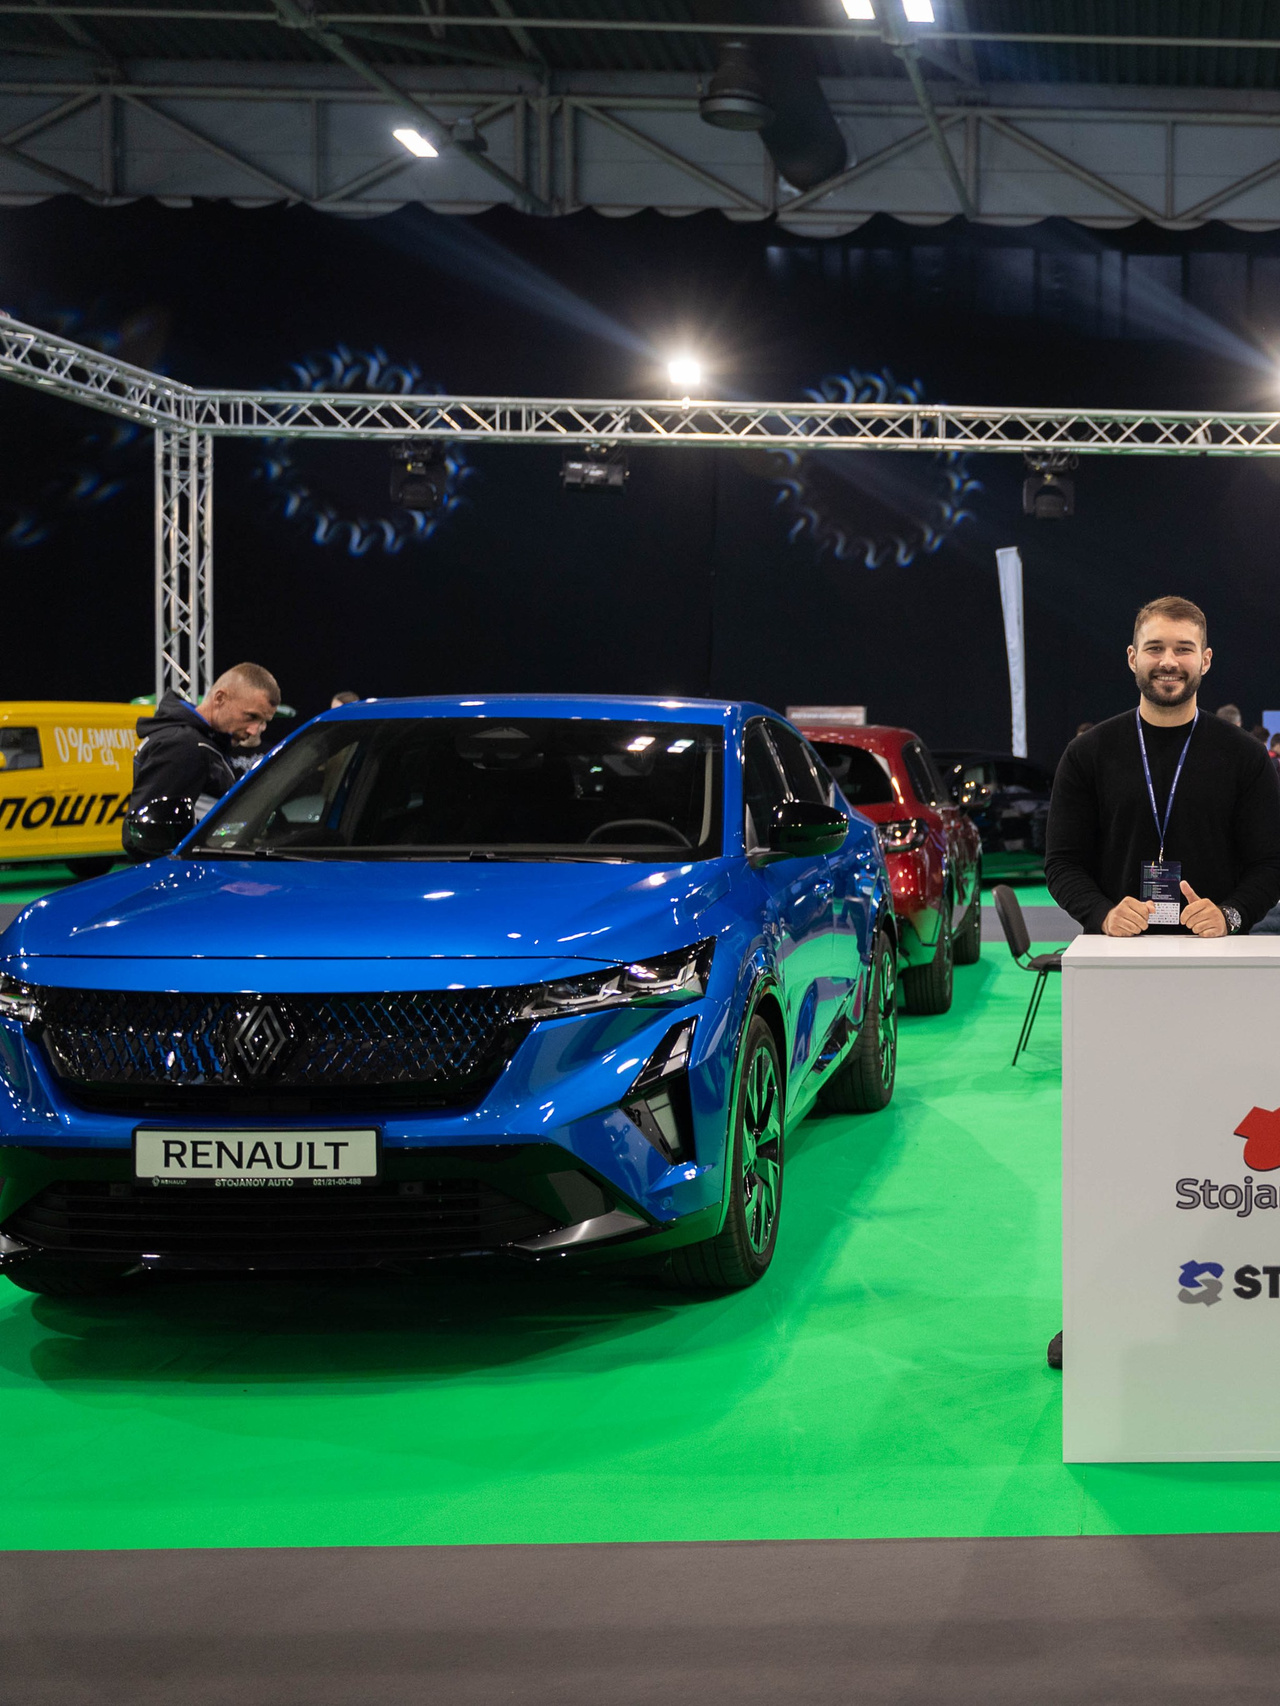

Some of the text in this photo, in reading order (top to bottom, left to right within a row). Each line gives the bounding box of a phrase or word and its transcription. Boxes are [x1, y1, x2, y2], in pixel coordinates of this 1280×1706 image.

[54, 727, 93, 763] 0%
[162, 1140, 349, 1170] RENAULT
[215, 1178, 294, 1187] STOJANOV AUTO
